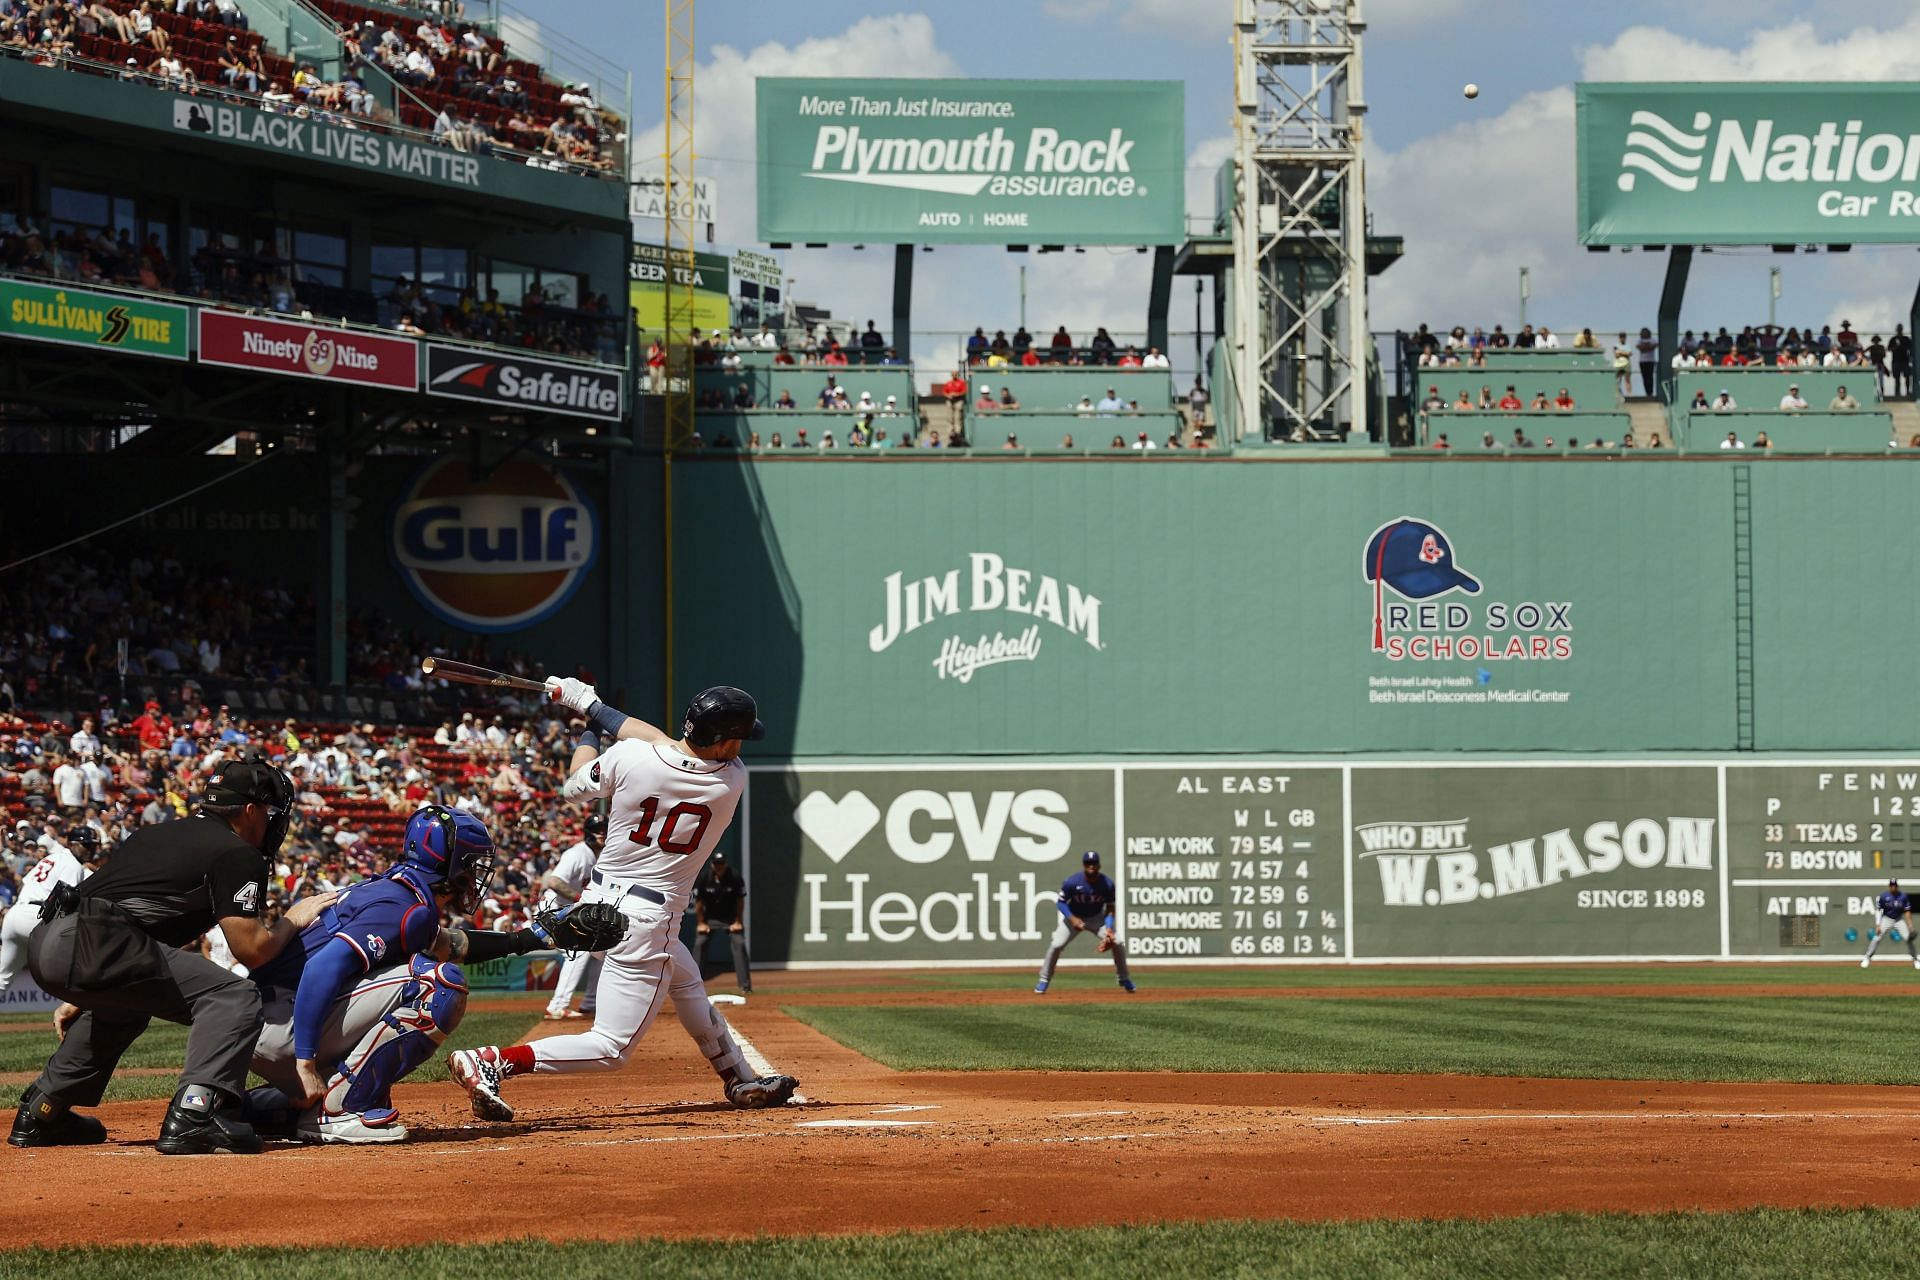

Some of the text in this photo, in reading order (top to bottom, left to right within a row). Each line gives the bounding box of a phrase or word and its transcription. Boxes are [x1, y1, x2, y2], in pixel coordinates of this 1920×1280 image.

[799, 96, 1015, 118] More Than Just Insurance.
[217, 107, 480, 187] BLACK LIVES MATTER
[812, 126, 1135, 176] Plymouth Rock
[989, 174, 1136, 197] assurance
[1817, 190, 1878, 217] Car
[918, 212, 1029, 227] AUTO HOME
[672, 267, 704, 286] TEA
[12, 293, 171, 344] SULLIVAN TIRE
[243, 331, 302, 364] Ninety
[336, 344, 379, 371] Nine
[497, 366, 618, 412] Safelite
[402, 505, 578, 563] Gulf
[869, 552, 1103, 653] JIM BEAM
[1388, 603, 1573, 631] RED SOX
[932, 624, 1042, 684] Highball
[1387, 636, 1573, 660] SCHOLARS
[1369, 689, 1570, 703] Beth Israel Deaconess Medical Center
[1176, 776, 1291, 794] AL EAST
[1767, 798, 1782, 816] P
[1873, 796, 1880, 816] 1
[1890, 796, 1903, 816] 2
[629, 797, 712, 855] 10
[885, 789, 1072, 864] CVS
[1234, 809, 1316, 827] W L GB
[1360, 824, 1468, 850] WHO BUT
[1764, 824, 1884, 843] 33 TEXAS 2
[1127, 836, 1284, 855] NEW YORK 79 54
[1128, 861, 1309, 880] TAMPA BAY 74 57 4
[1765, 851, 1784, 870] 73
[1790, 851, 1863, 870] BOSTON
[234, 881, 259, 911] 4
[1128, 886, 1214, 905] TORONTO
[1230, 886, 1255, 905] 72
[1259, 886, 1285, 904] 59
[1295, 886, 1309, 904] 6
[1577, 889, 1706, 908] SINCE 1898
[1766, 896, 1829, 915] AT BAT
[1847, 896, 1881, 915] BA
[804, 872, 1060, 943] Health
[1127, 911, 1223, 930] BALTIMORE
[1233, 911, 1253, 929] 71
[1262, 911, 1282, 929] 61
[1296, 911, 1309, 929] 7
[1128, 937, 1201, 955] BOSTON
[1230, 936, 1256, 954] 66
[1259, 936, 1285, 954] 68
[1293, 936, 1313, 954] 13
[470, 959, 511, 977] TRULY
